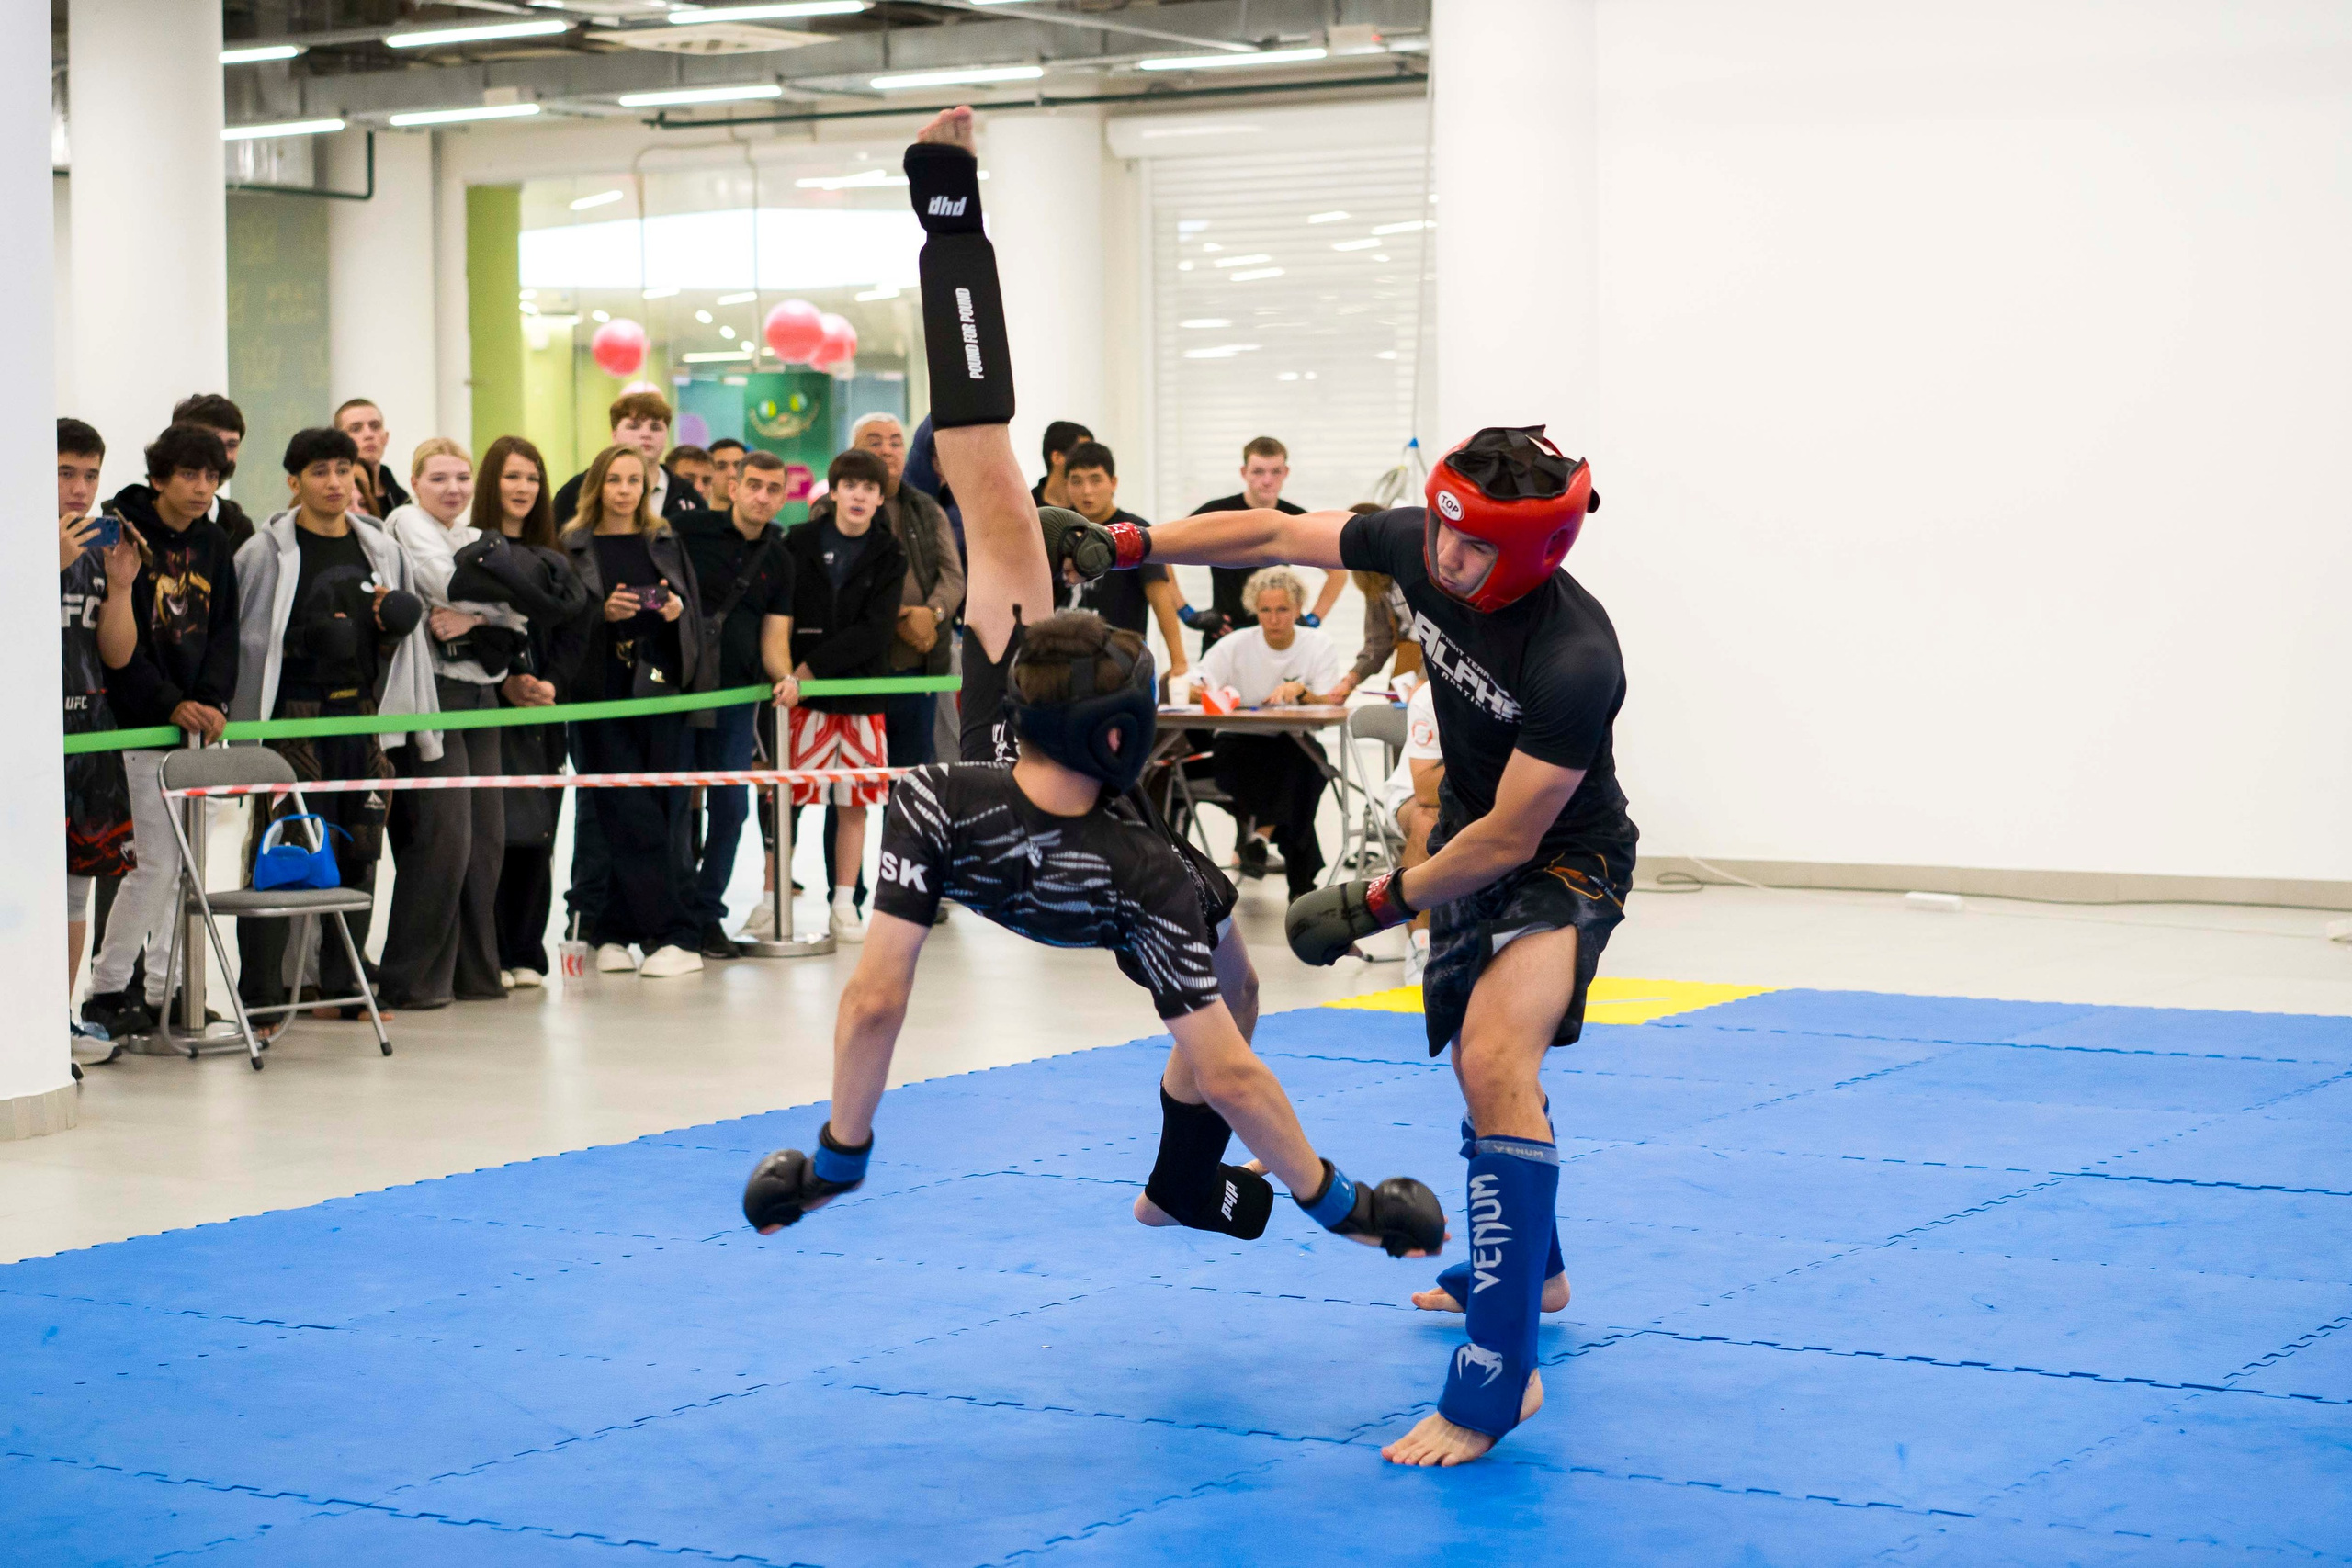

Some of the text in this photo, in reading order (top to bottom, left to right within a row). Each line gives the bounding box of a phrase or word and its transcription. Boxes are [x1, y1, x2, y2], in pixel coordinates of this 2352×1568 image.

[927, 195, 967, 217] dhd
[956, 288, 984, 378] POUND FOR POUND
[1442, 494, 1459, 512] TOP
[61, 592, 101, 628] FC
[1439, 632, 1464, 657] FIGHT
[65, 695, 88, 710] UFC
[1494, 1145, 1544, 1158] VENUM
[1220, 1179, 1238, 1222] dhd
[1469, 1173, 1513, 1294] VENUM
